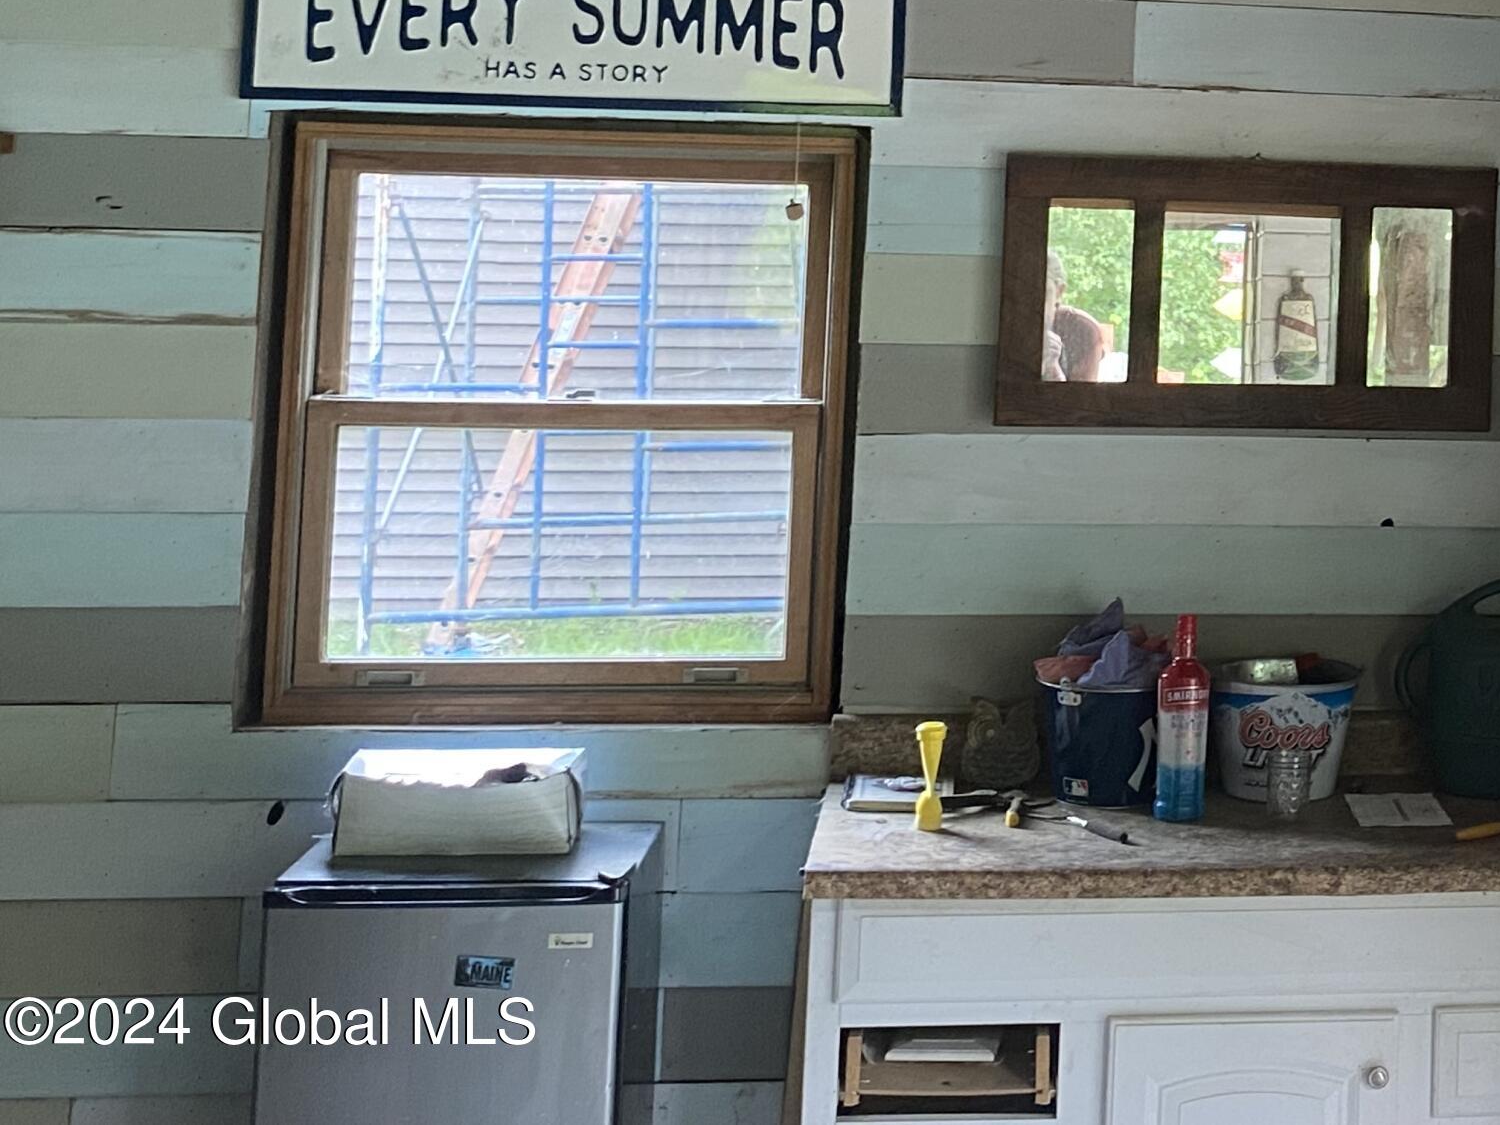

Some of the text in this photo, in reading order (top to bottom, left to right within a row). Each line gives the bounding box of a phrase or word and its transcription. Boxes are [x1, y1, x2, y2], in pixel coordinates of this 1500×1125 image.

[484, 59, 669, 83] HAS A STORY
[1239, 708, 1330, 750] Coors
[1242, 748, 1326, 768] LIT
[470, 961, 512, 984] MAINE
